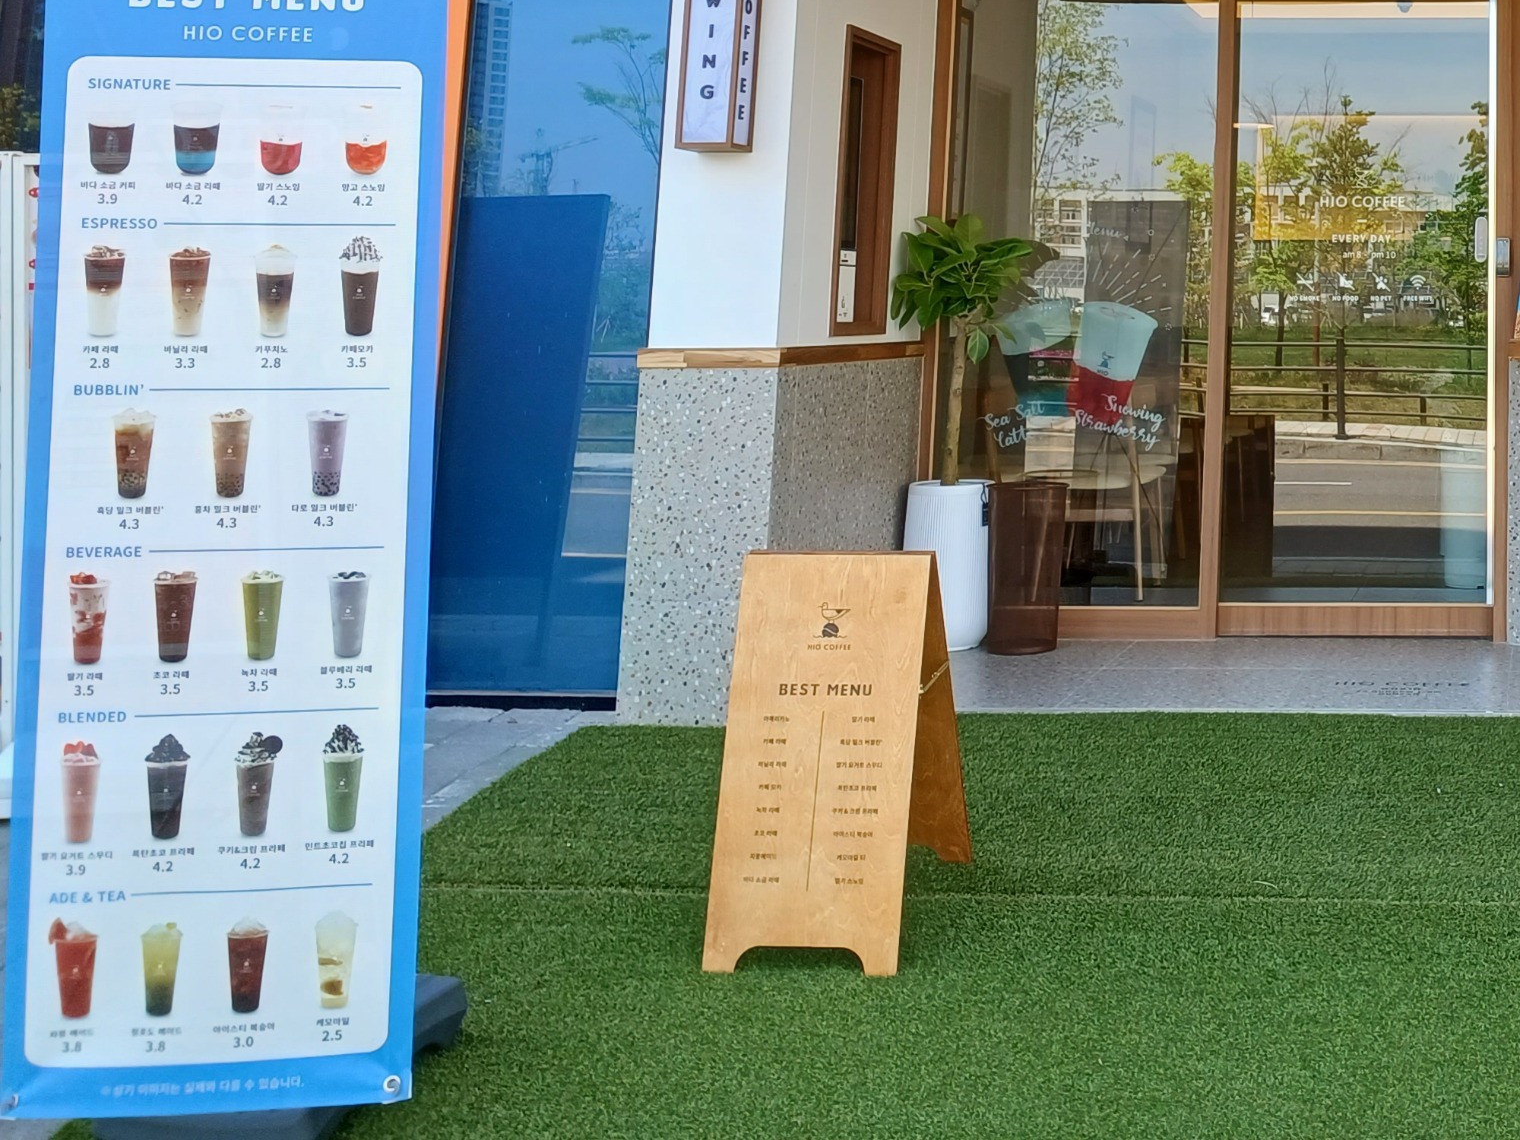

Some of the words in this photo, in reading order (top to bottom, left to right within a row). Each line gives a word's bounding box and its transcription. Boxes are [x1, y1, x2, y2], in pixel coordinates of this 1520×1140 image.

[183, 25, 223, 42] HIO
[231, 26, 314, 44] COFFEE
[88, 77, 171, 91] SIGNATURE
[97, 193, 118, 206] 3.9
[182, 193, 203, 206] 4.2
[267, 194, 289, 207] 4.2
[352, 195, 374, 208] 4.2
[1320, 196, 1347, 208] HIO
[1352, 196, 1405, 208] COFFEE
[81, 217, 158, 230] ESPRESSO
[1332, 234, 1366, 243] EVERY
[1370, 234, 1392, 243] DAY
[89, 357, 110, 370] 2.8
[175, 357, 196, 370] 3.3
[260, 357, 282, 370] 2.8
[346, 357, 368, 370] 3.5
[73, 384, 145, 396] BUBBLIN'
[1102, 394, 1165, 432] Snowing
[1070, 408, 1160, 451] Strawberry
[119, 518, 140, 530] 4.3
[216, 517, 238, 529] 4.3
[313, 516, 334, 528] 4.3
[65, 545, 143, 559] BEVERAGE
[160, 683, 181, 696] 3.5
[248, 680, 269, 693] 3.5
[335, 677, 356, 690] 3.5
[779, 683, 820, 697] BEST
[827, 683, 873, 697] MENU
[73, 685, 95, 697] 3.5
[57, 711, 127, 724] BLENDED
[240, 857, 261, 870] 4.2
[329, 853, 350, 865] 4.2
[65, 864, 87, 877] 3.9
[152, 860, 174, 873] 4.2
[49, 892, 79, 904] ADE
[81, 891, 94, 904] &
[99, 890, 127, 903] TEA
[233, 1036, 254, 1048] 3.0
[322, 1030, 343, 1042] 2.5
[62, 1040, 83, 1053] 3.8
[145, 1040, 167, 1053] 3.8
